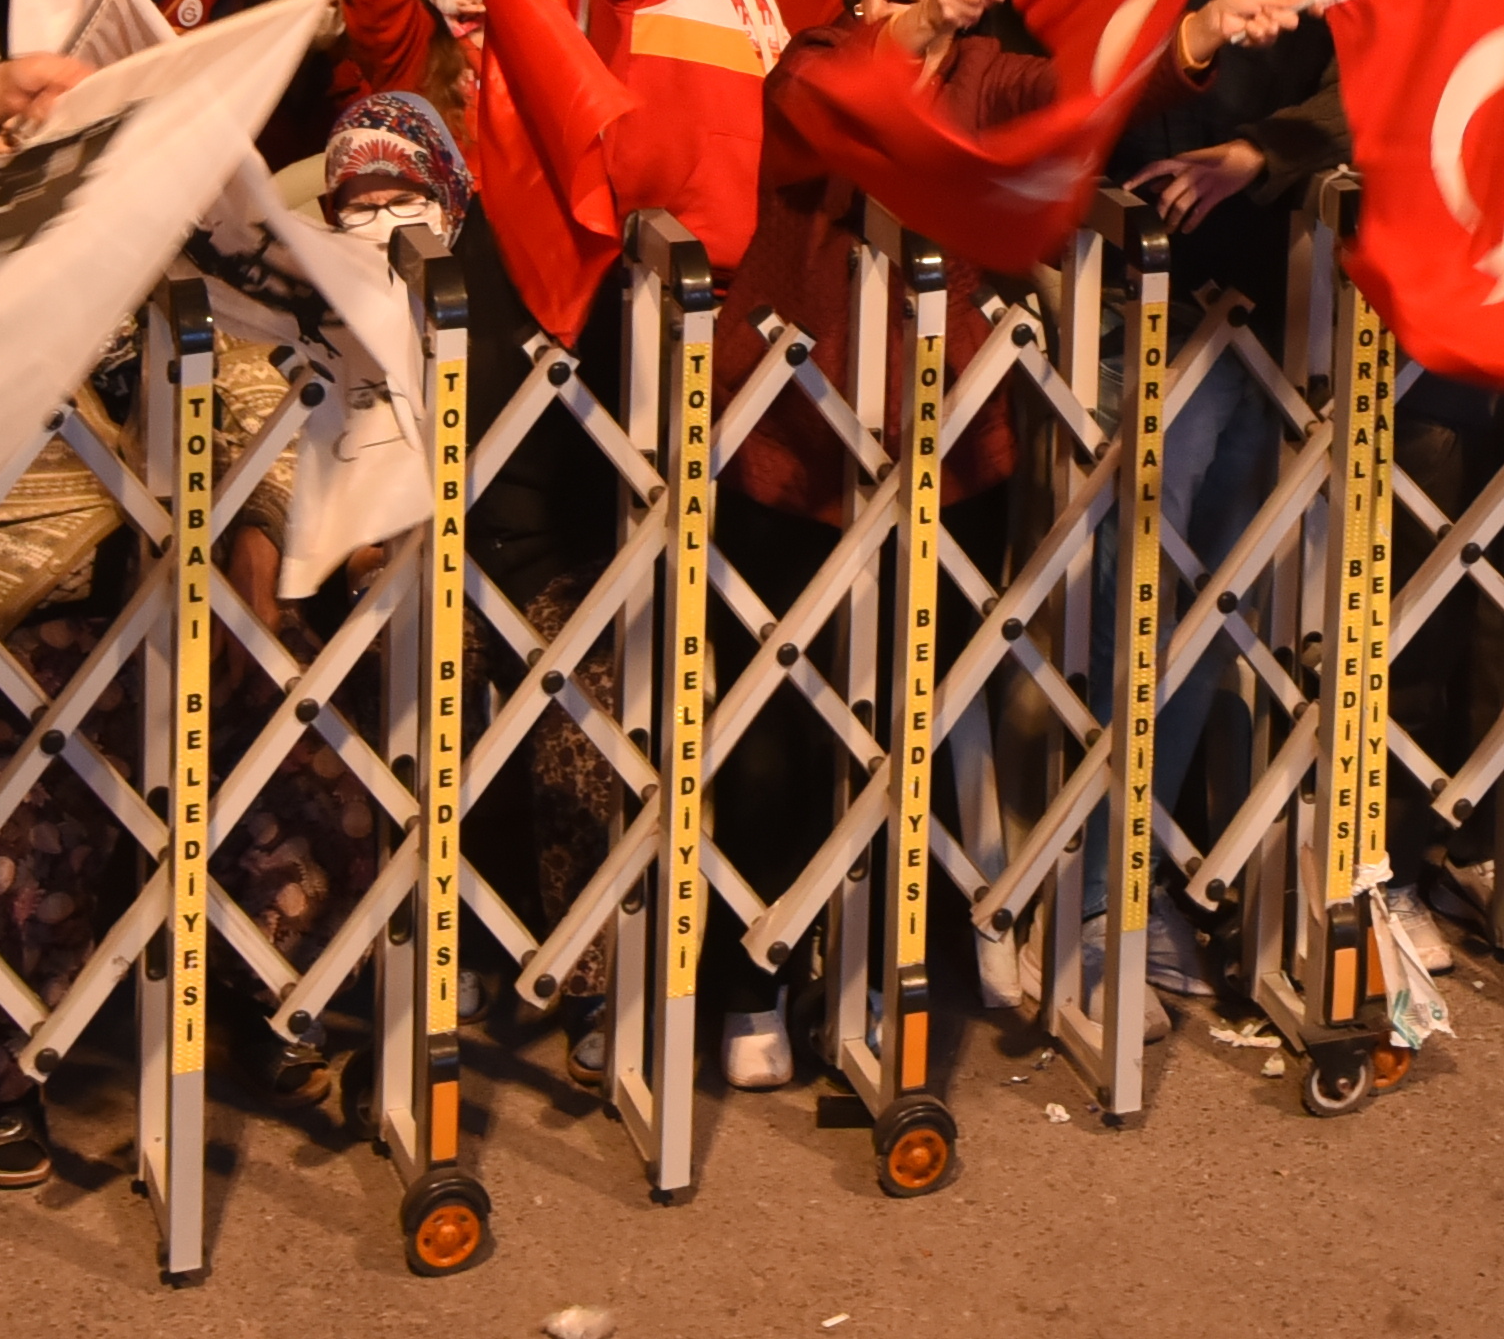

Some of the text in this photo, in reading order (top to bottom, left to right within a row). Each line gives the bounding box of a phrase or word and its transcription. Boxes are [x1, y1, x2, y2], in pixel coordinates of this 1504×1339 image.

[181, 398, 205, 1043] TORBALI BELEDİYESİ
[437, 373, 459, 1000] TORBALI BELEDİYESİ
[677, 355, 706, 969] TORBALI BELEDİYESİ
[910, 335, 938, 934] TORBALI BELEDİYESİ
[1132, 314, 1161, 902] TORBALI BELEDİYESİ
[1338, 560, 1362, 872] BELEDİYESİ
[1370, 547, 1386, 851] BELEDİYESİ
